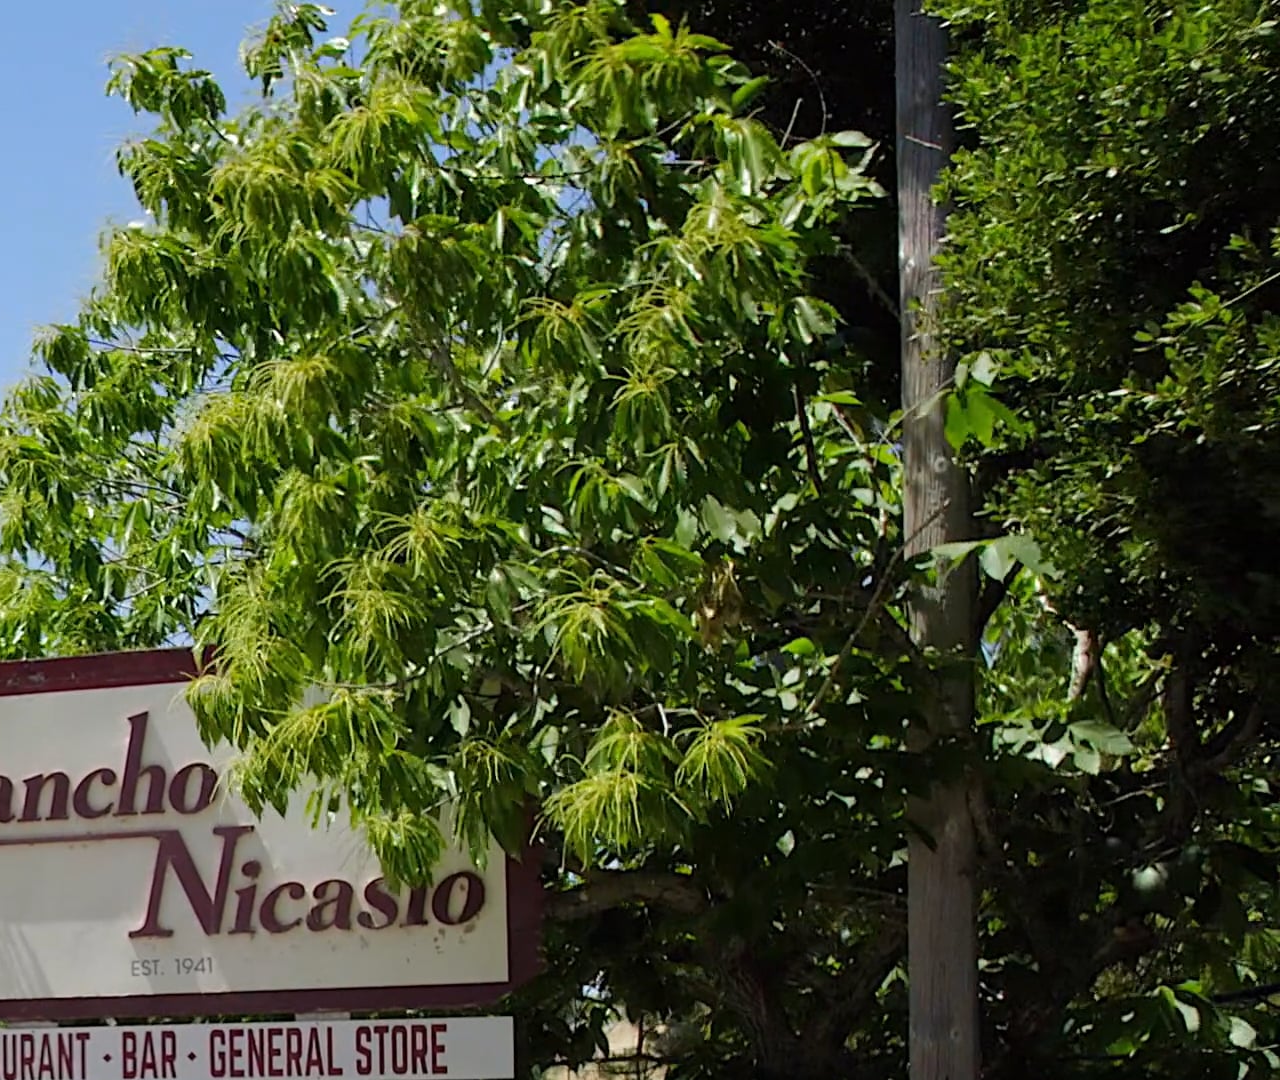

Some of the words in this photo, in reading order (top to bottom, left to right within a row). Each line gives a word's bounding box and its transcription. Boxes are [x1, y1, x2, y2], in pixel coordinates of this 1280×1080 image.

[128, 825, 486, 938] Nicasio
[131, 959, 166, 977] EST.
[174, 957, 214, 975] 1941
[122, 1030, 177, 1080] BAR
[209, 1027, 343, 1078] GENERAL
[355, 1023, 448, 1075] STORE
